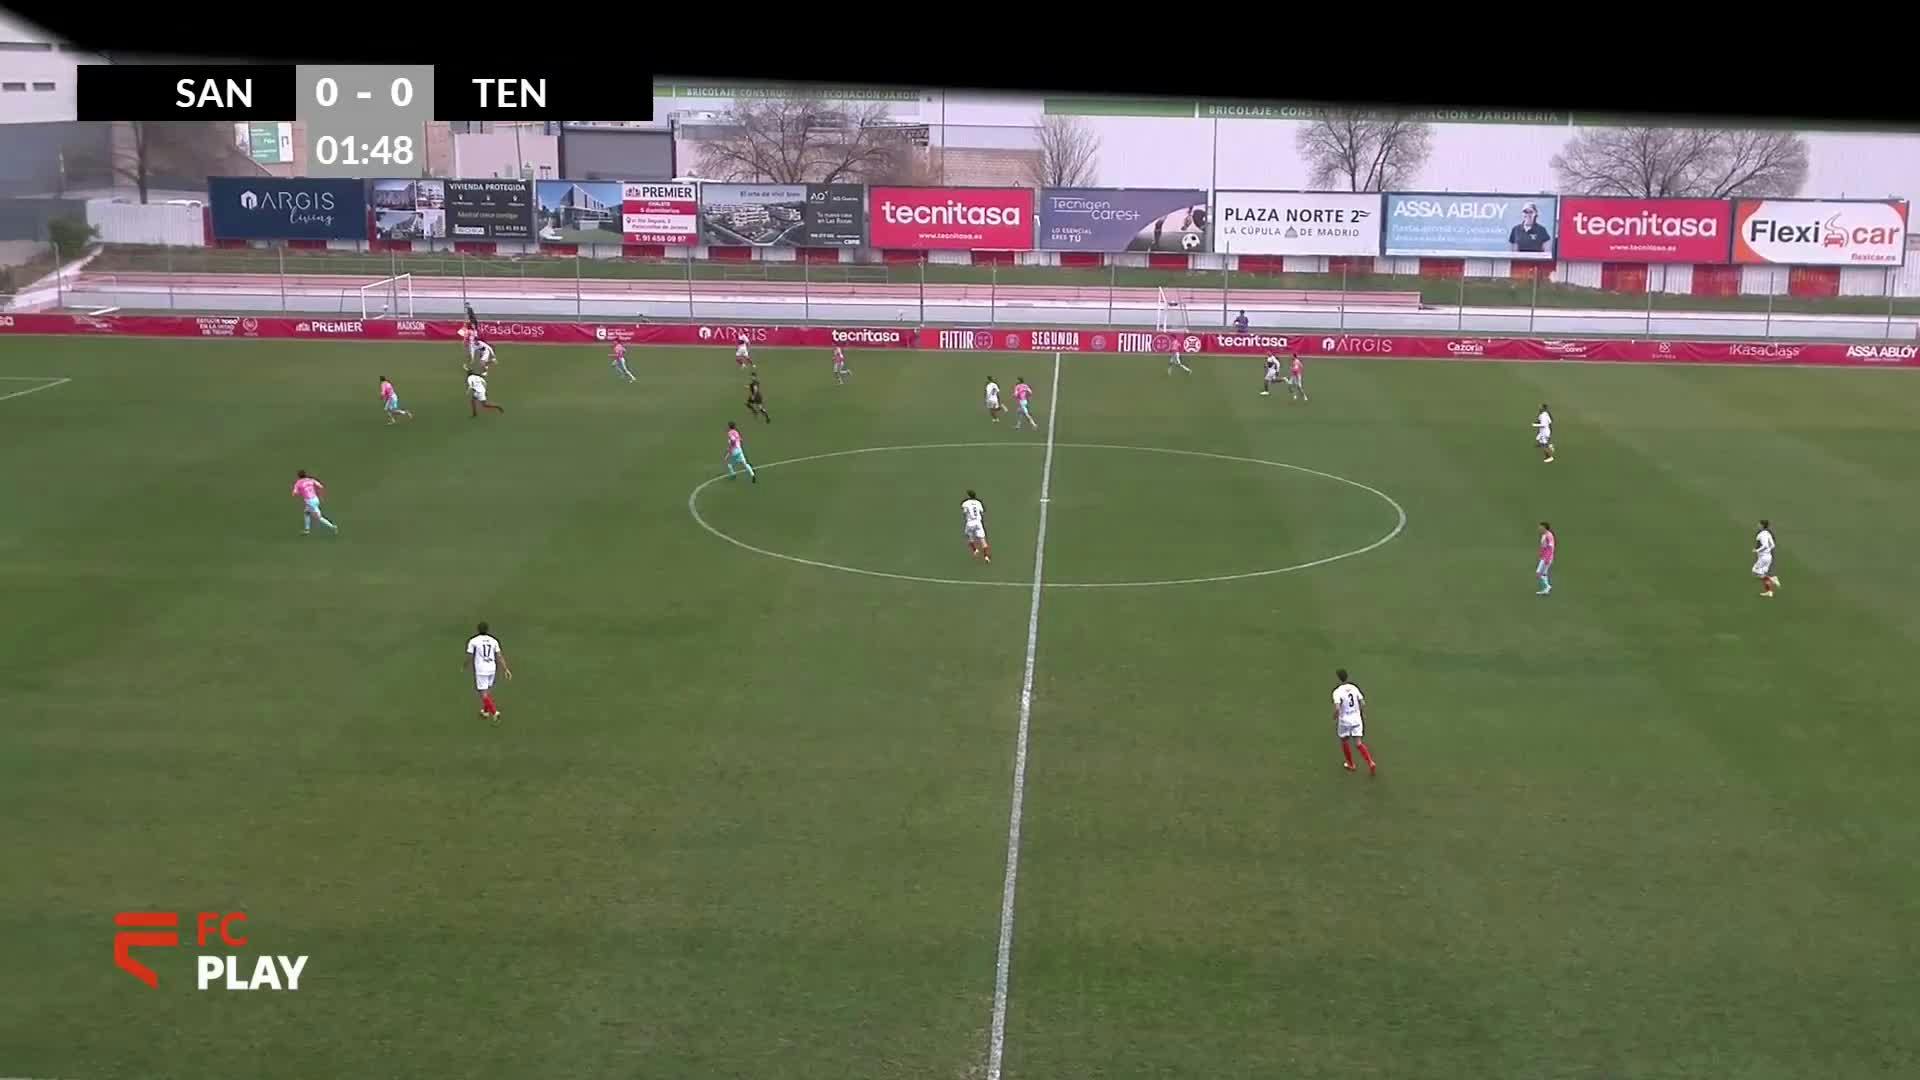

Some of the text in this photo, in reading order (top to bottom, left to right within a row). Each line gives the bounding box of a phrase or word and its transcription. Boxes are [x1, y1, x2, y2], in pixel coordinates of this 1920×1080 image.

[1208, 104, 1272, 116] BRICOLAJE
[450, 183, 526, 192] VIVIENDA PROTEGIDA
[642, 186, 692, 198] PREMIER
[260, 191, 335, 210] ARGIS
[1050, 197, 1111, 212] Tecnigen
[881, 200, 1020, 225] tecnitasa
[1224, 208, 1360, 223] PLAZA NORTE 2
[1393, 201, 1508, 219] ASSA ABLOY
[1573, 210, 1717, 236] tecnitasa
[1062, 227, 1092, 235] ESENCIAL
[1224, 226, 1360, 237] LA CÚPULA DE MADRID
[1750, 220, 1900, 244] Flexi car
[1068, 234, 1082, 243] TÚ
[1851, 253, 1896, 261] flexicar.es
[312, 321, 363, 332] PREMIER
[832, 329, 900, 342] tecnitasa
[1031, 331, 1079, 345] SEGUNDA
[1118, 333, 1152, 352] FUTUR
[1217, 334, 1288, 347] tecnitasa
[1336, 338, 1393, 352] ARGIS
[1846, 346, 1918, 358] ASSA ABLOY
[482, 644, 492, 658] 17
[1348, 693, 1355, 707] 3
